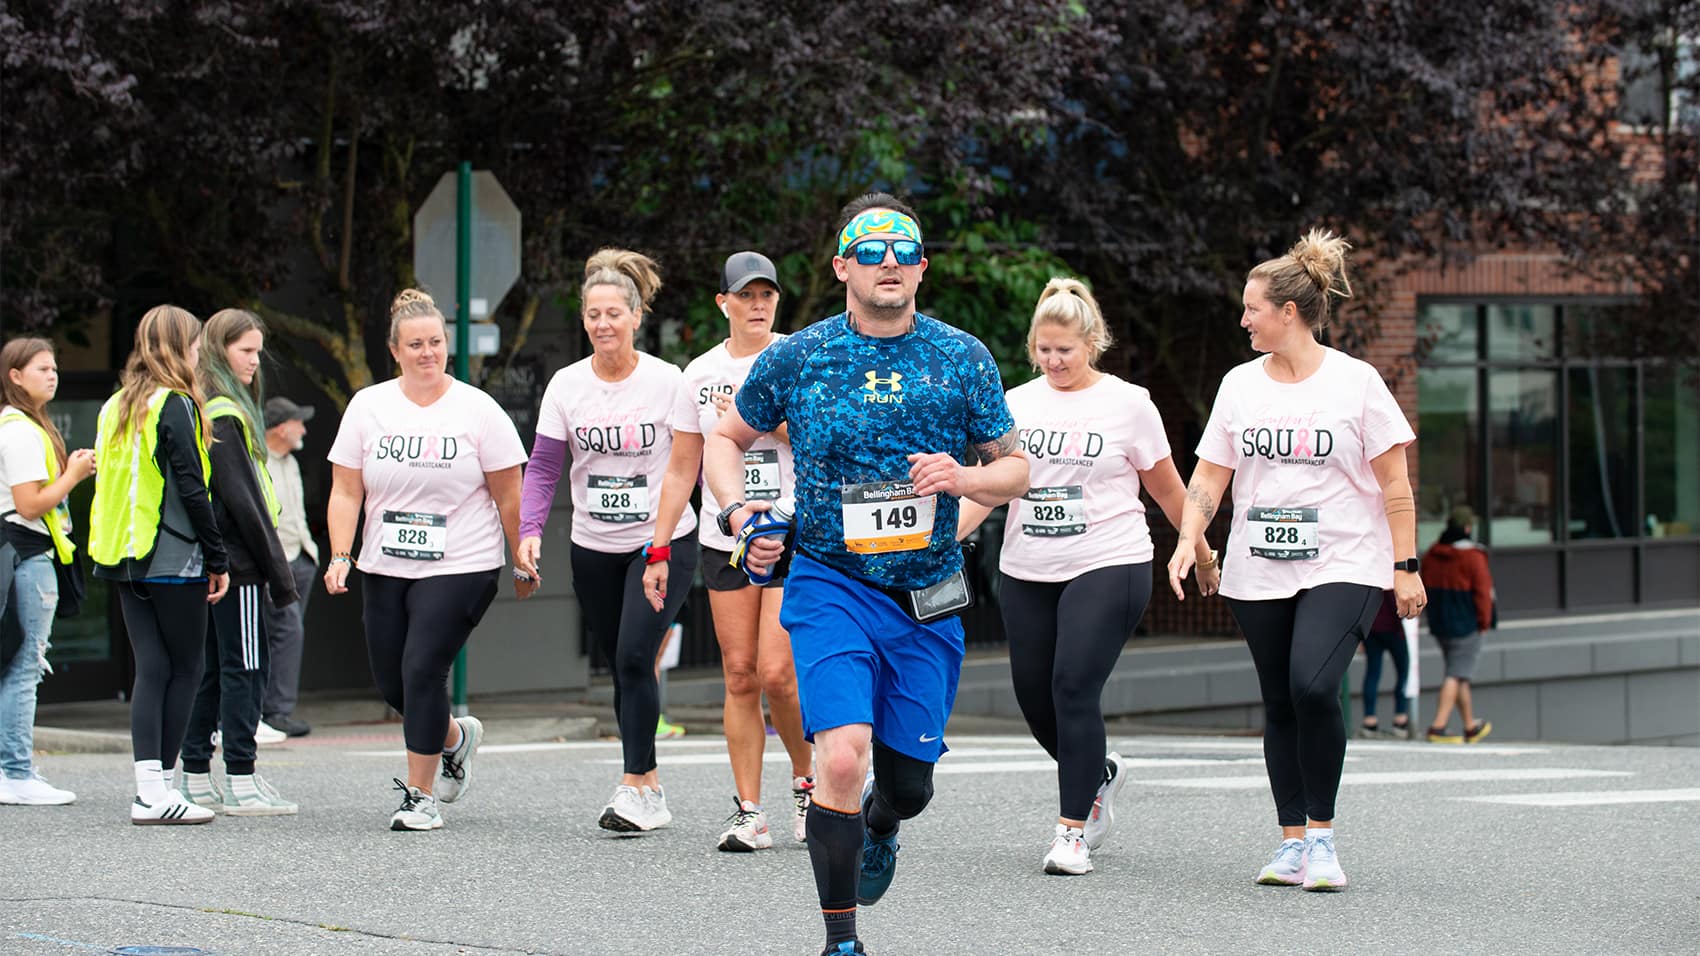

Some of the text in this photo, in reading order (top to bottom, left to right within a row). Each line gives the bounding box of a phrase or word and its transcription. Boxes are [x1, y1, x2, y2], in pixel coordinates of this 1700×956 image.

[863, 393, 903, 404] RUN
[408, 461, 452, 469] #BREASTCANCER
[1049, 458, 1093, 467] #BREASTCANCER
[1281, 458, 1325, 466] #BREASTCANCER
[601, 493, 631, 508] 828
[863, 489, 906, 499] Bellingham
[871, 505, 918, 531] 149
[1033, 505, 1066, 521] 828
[397, 528, 428, 545] 828
[1264, 526, 1299, 544] 828
